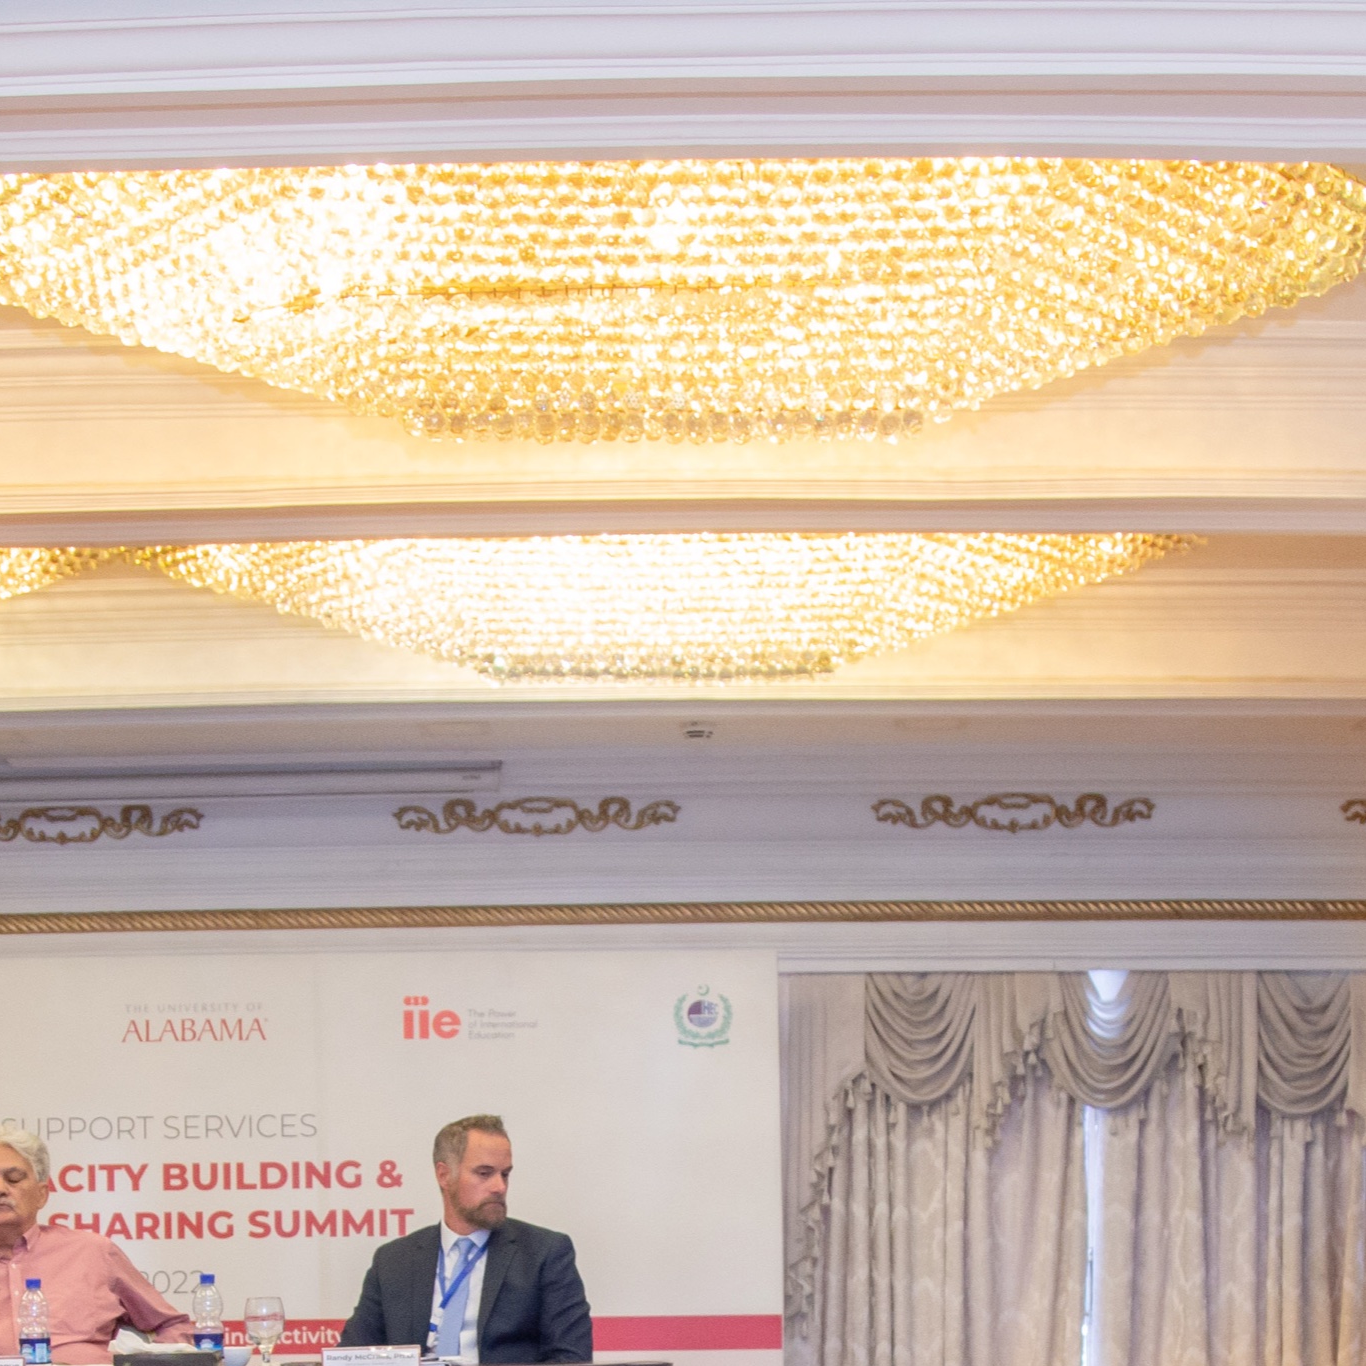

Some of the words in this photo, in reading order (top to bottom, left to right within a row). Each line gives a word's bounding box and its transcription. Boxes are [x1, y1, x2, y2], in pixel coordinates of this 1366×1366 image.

[125, 1003, 149, 1014] THE
[156, 1002, 239, 1014] UNIVERSITY
[121, 1017, 267, 1043] ALABAMA
[162, 1113, 318, 1139] SERVICES
[162, 1160, 363, 1192] BUILDING
[375, 1160, 404, 1189] &
[247, 1208, 415, 1239] SUMMIT
[326, 1354, 353, 1362] Randy
